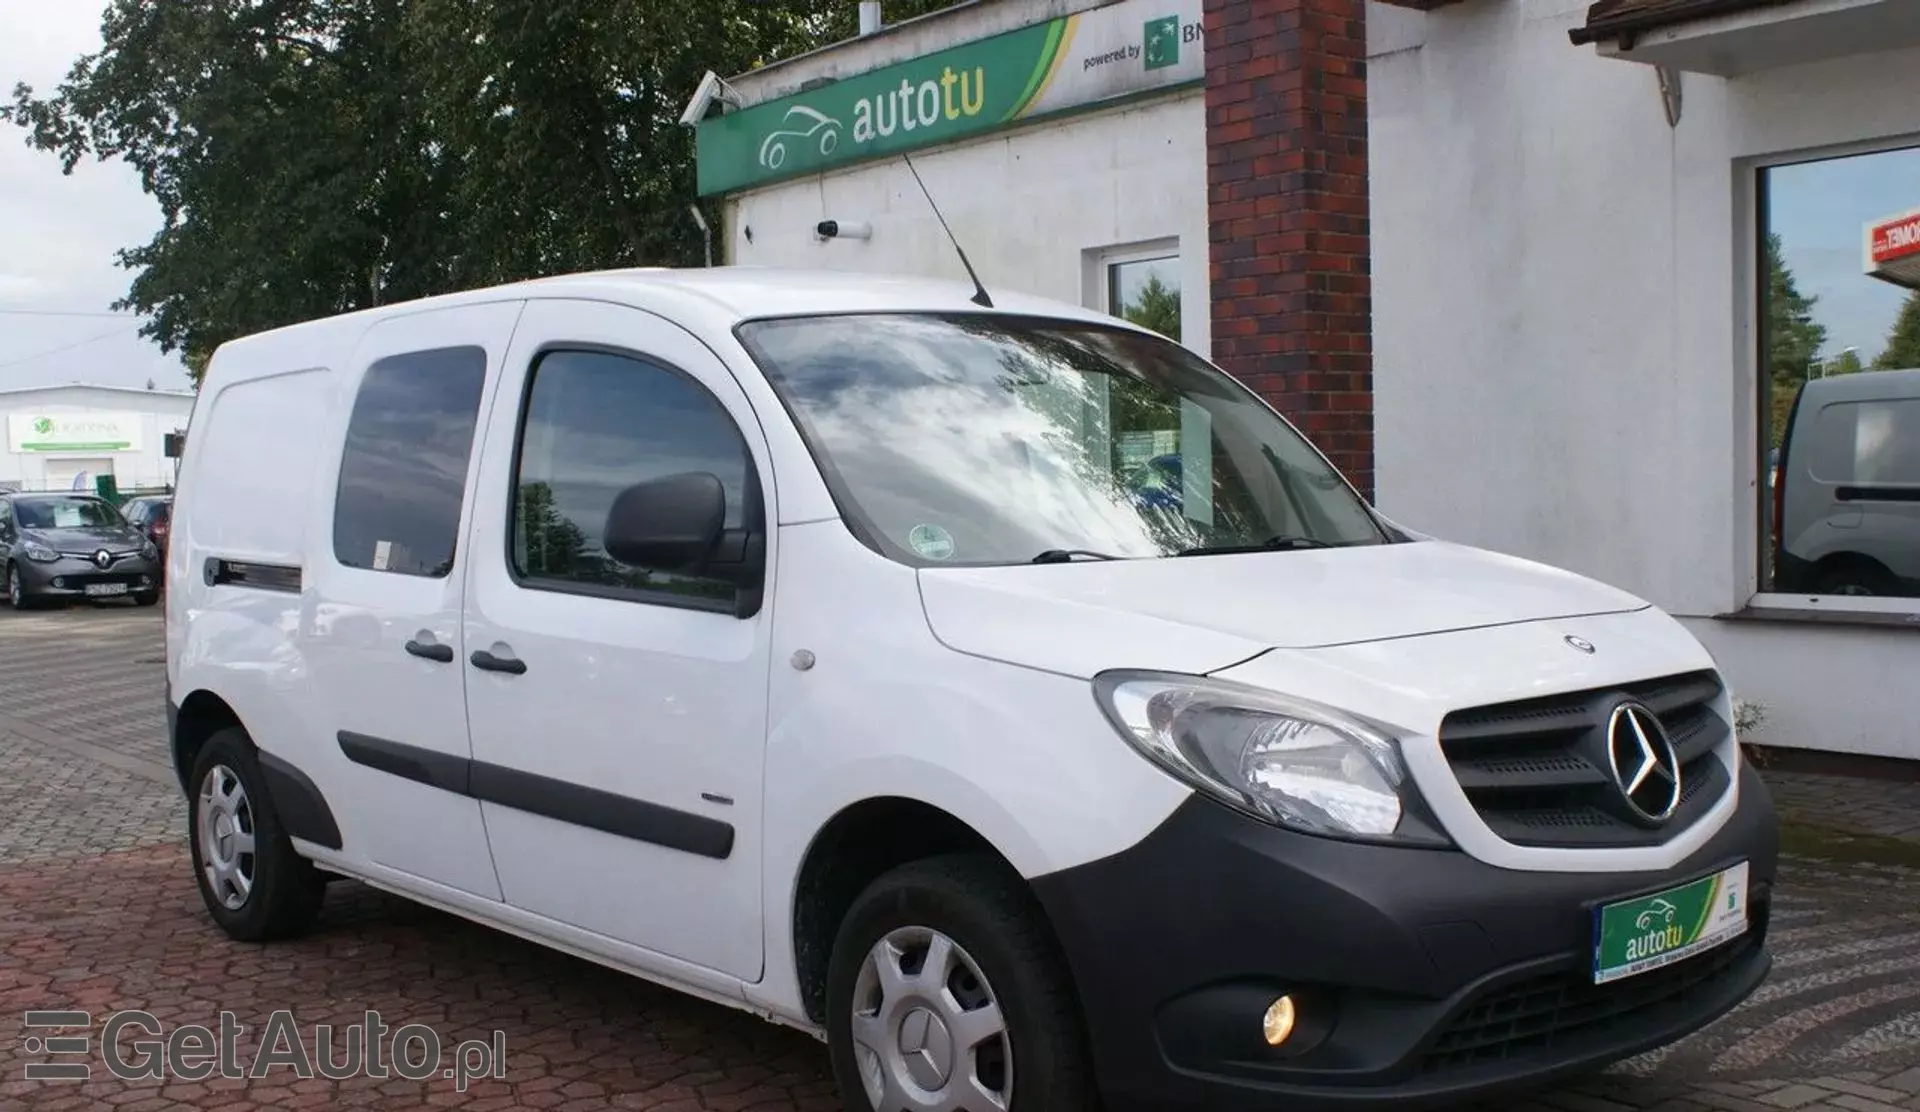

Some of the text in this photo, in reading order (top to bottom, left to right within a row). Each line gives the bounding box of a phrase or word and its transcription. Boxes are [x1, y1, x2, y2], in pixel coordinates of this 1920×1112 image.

[1083, 43, 1141, 73] powered by
[853, 66, 985, 144] autotu
[1626, 923, 1683, 961] autotu
